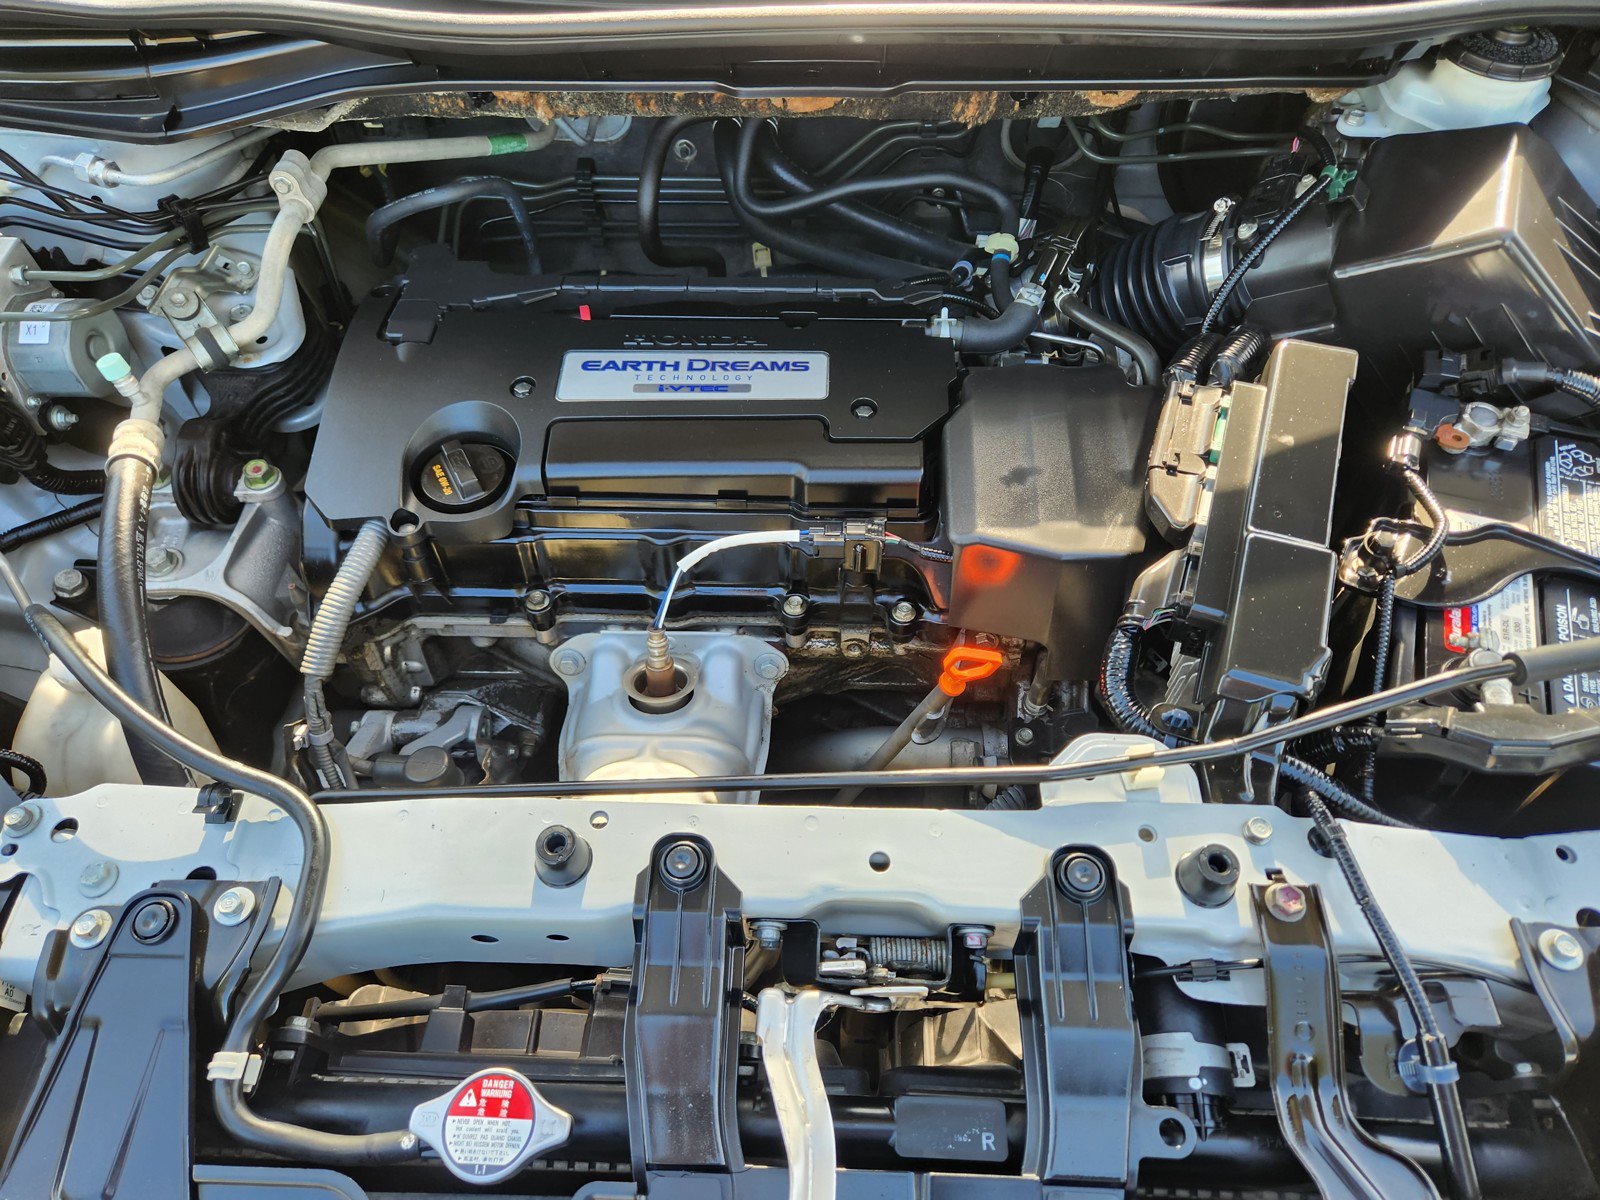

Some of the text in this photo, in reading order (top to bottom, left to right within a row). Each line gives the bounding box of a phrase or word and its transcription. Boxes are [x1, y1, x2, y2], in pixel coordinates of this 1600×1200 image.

[25, 324, 37, 336] X1
[581, 358, 810, 372] EARTH DREAMS
[658, 385, 729, 393] i-VTEC
[432, 464, 445, 478] SAE
[438, 476, 453, 496] 0W-20
[1556, 604, 1569, 641] POISON
[482, 1079, 514, 1089] DANGER
[481, 1088, 513, 1099] WARNUNG
[981, 1132, 996, 1151] R
[474, 1164, 487, 1175] 1.1
